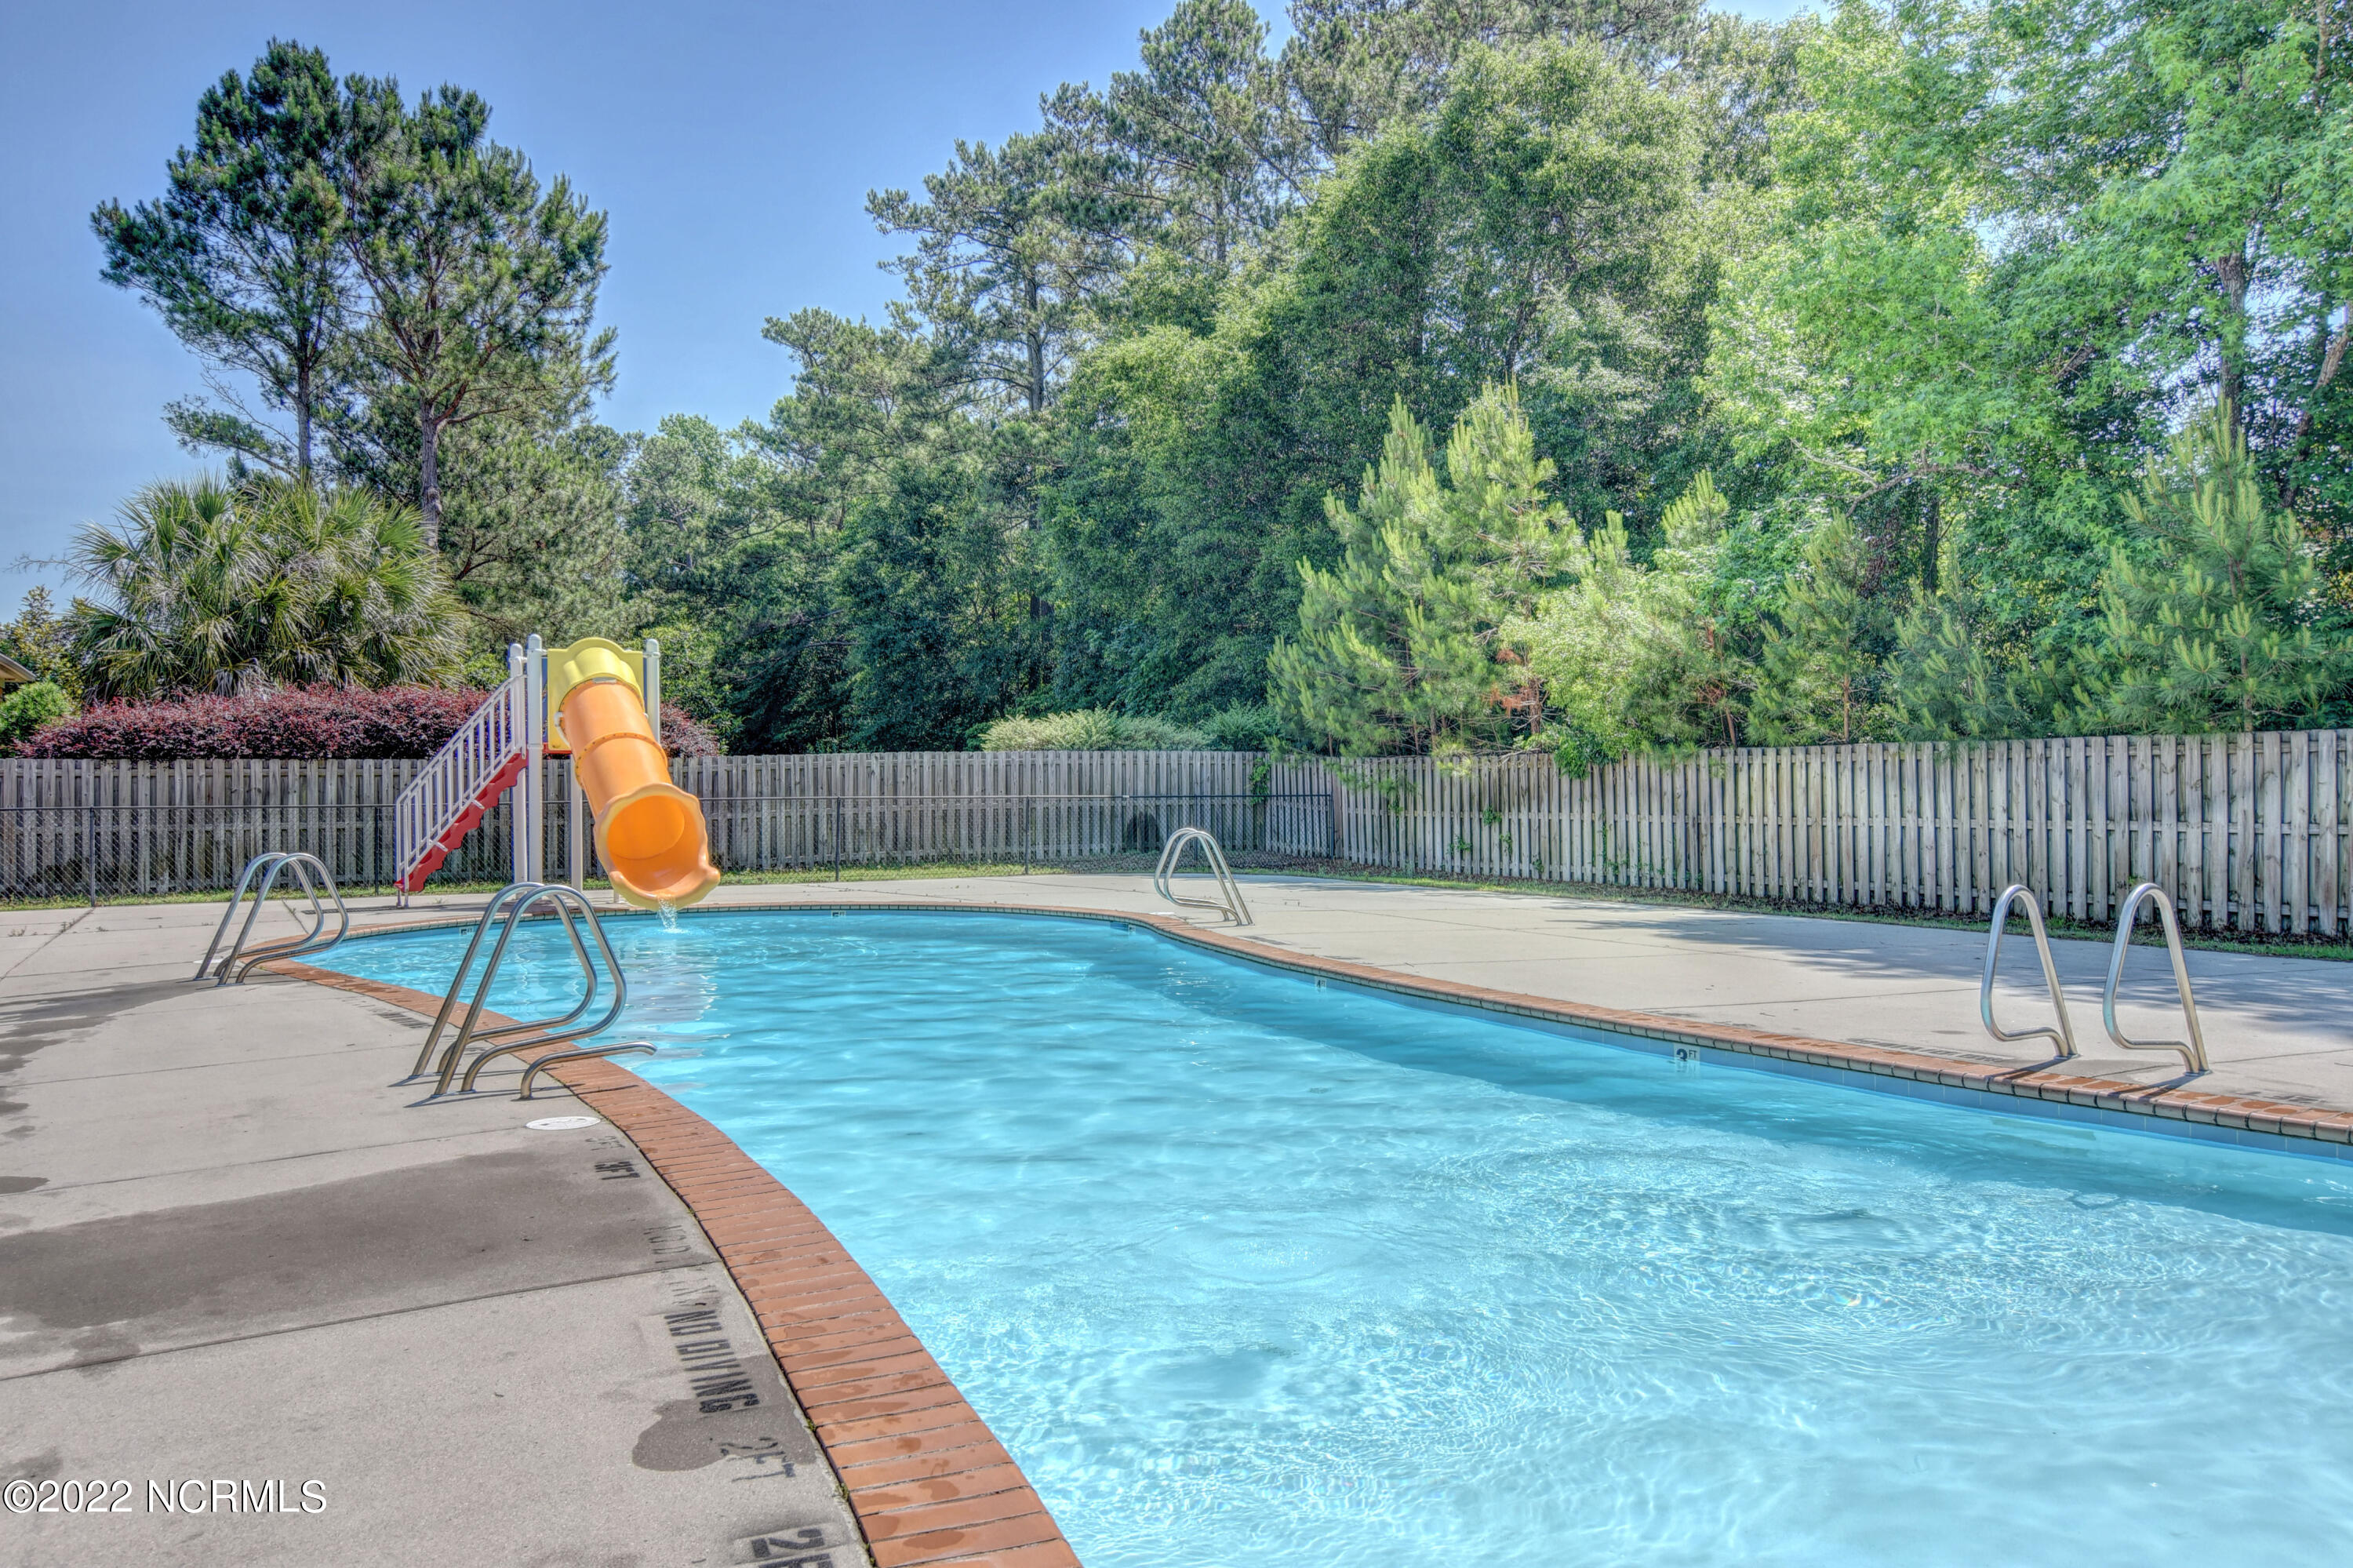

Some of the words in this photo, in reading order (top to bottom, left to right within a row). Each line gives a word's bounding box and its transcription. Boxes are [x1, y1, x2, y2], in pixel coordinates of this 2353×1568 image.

[664, 1310, 722, 1337] NO
[675, 1339, 759, 1413] DIVING
[718, 1436, 796, 1483] 2FT
